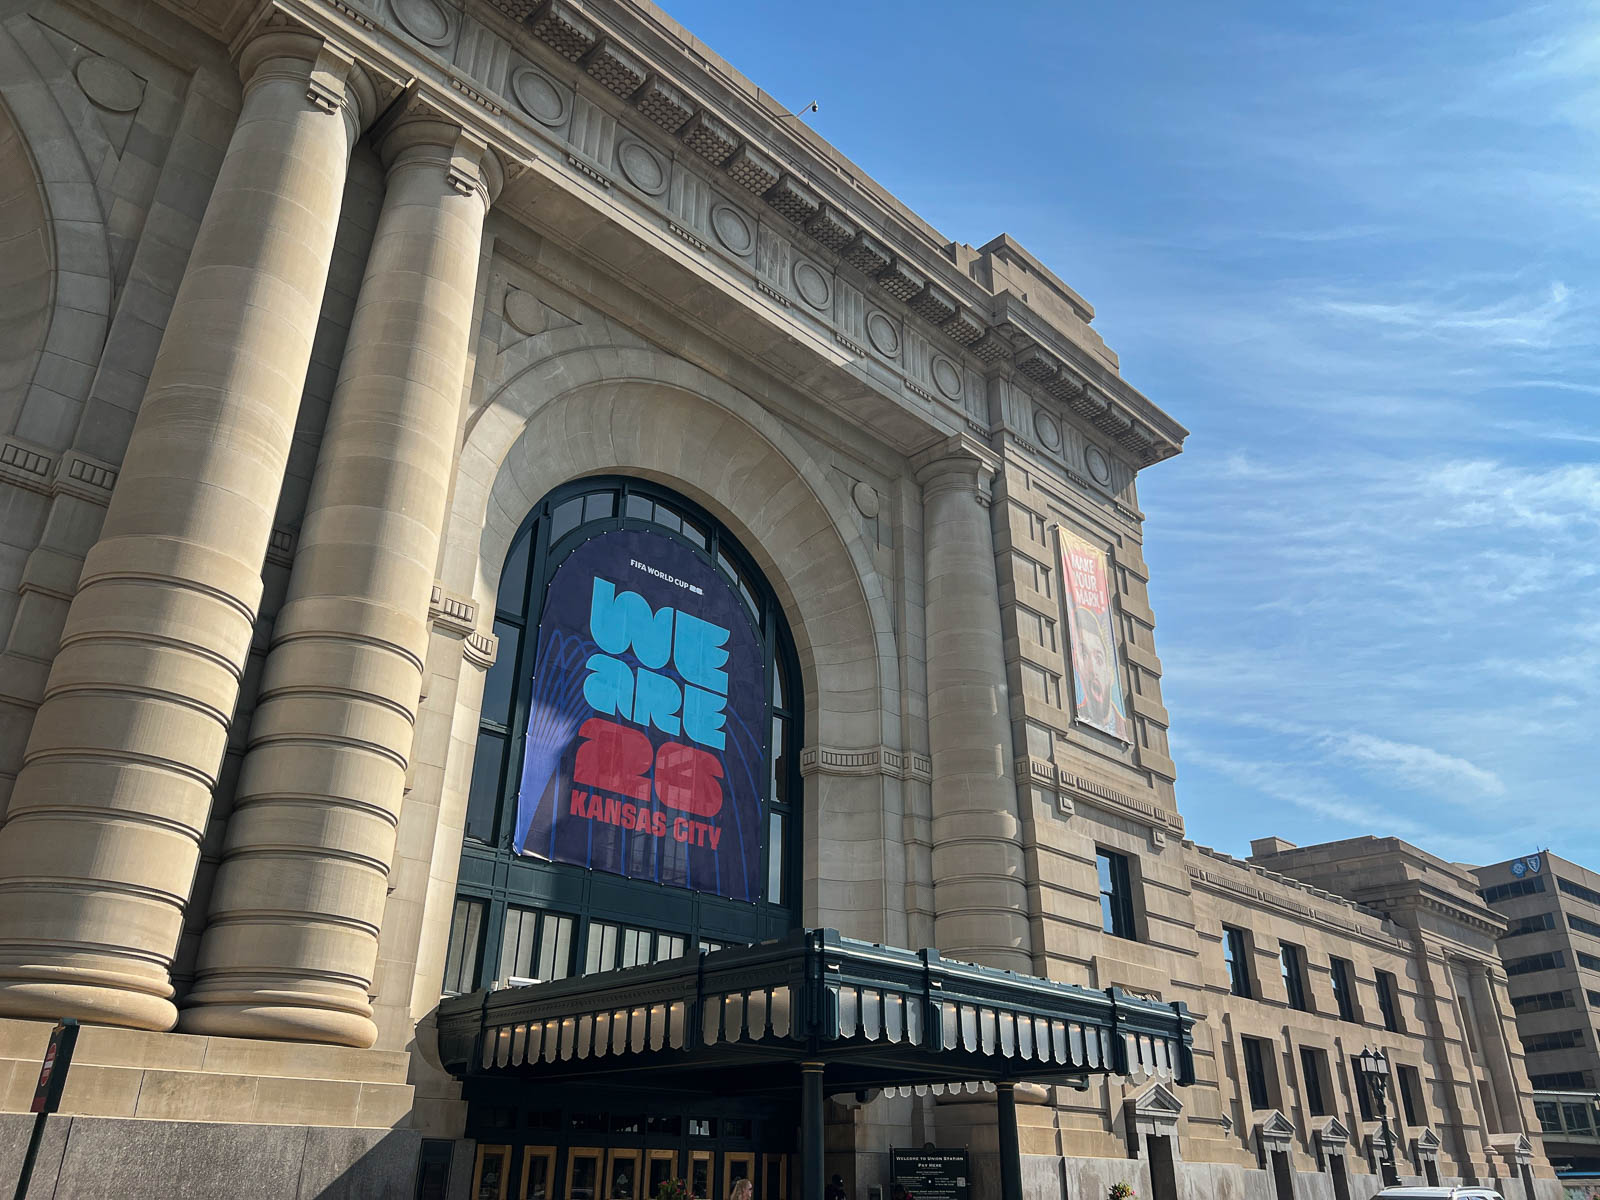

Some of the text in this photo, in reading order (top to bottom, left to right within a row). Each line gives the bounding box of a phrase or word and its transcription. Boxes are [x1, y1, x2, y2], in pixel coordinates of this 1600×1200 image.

[630, 559, 647, 572] FIFA
[647, 566, 674, 583] WORLD
[674, 578, 689, 589] CUP
[1072, 554, 1094, 574] MAKE
[1072, 570, 1097, 591] YOUR
[590, 576, 730, 695] WE
[583, 653, 728, 751] ARE
[573, 717, 725, 818] 26
[569, 789, 722, 850] KANSAS CITY
